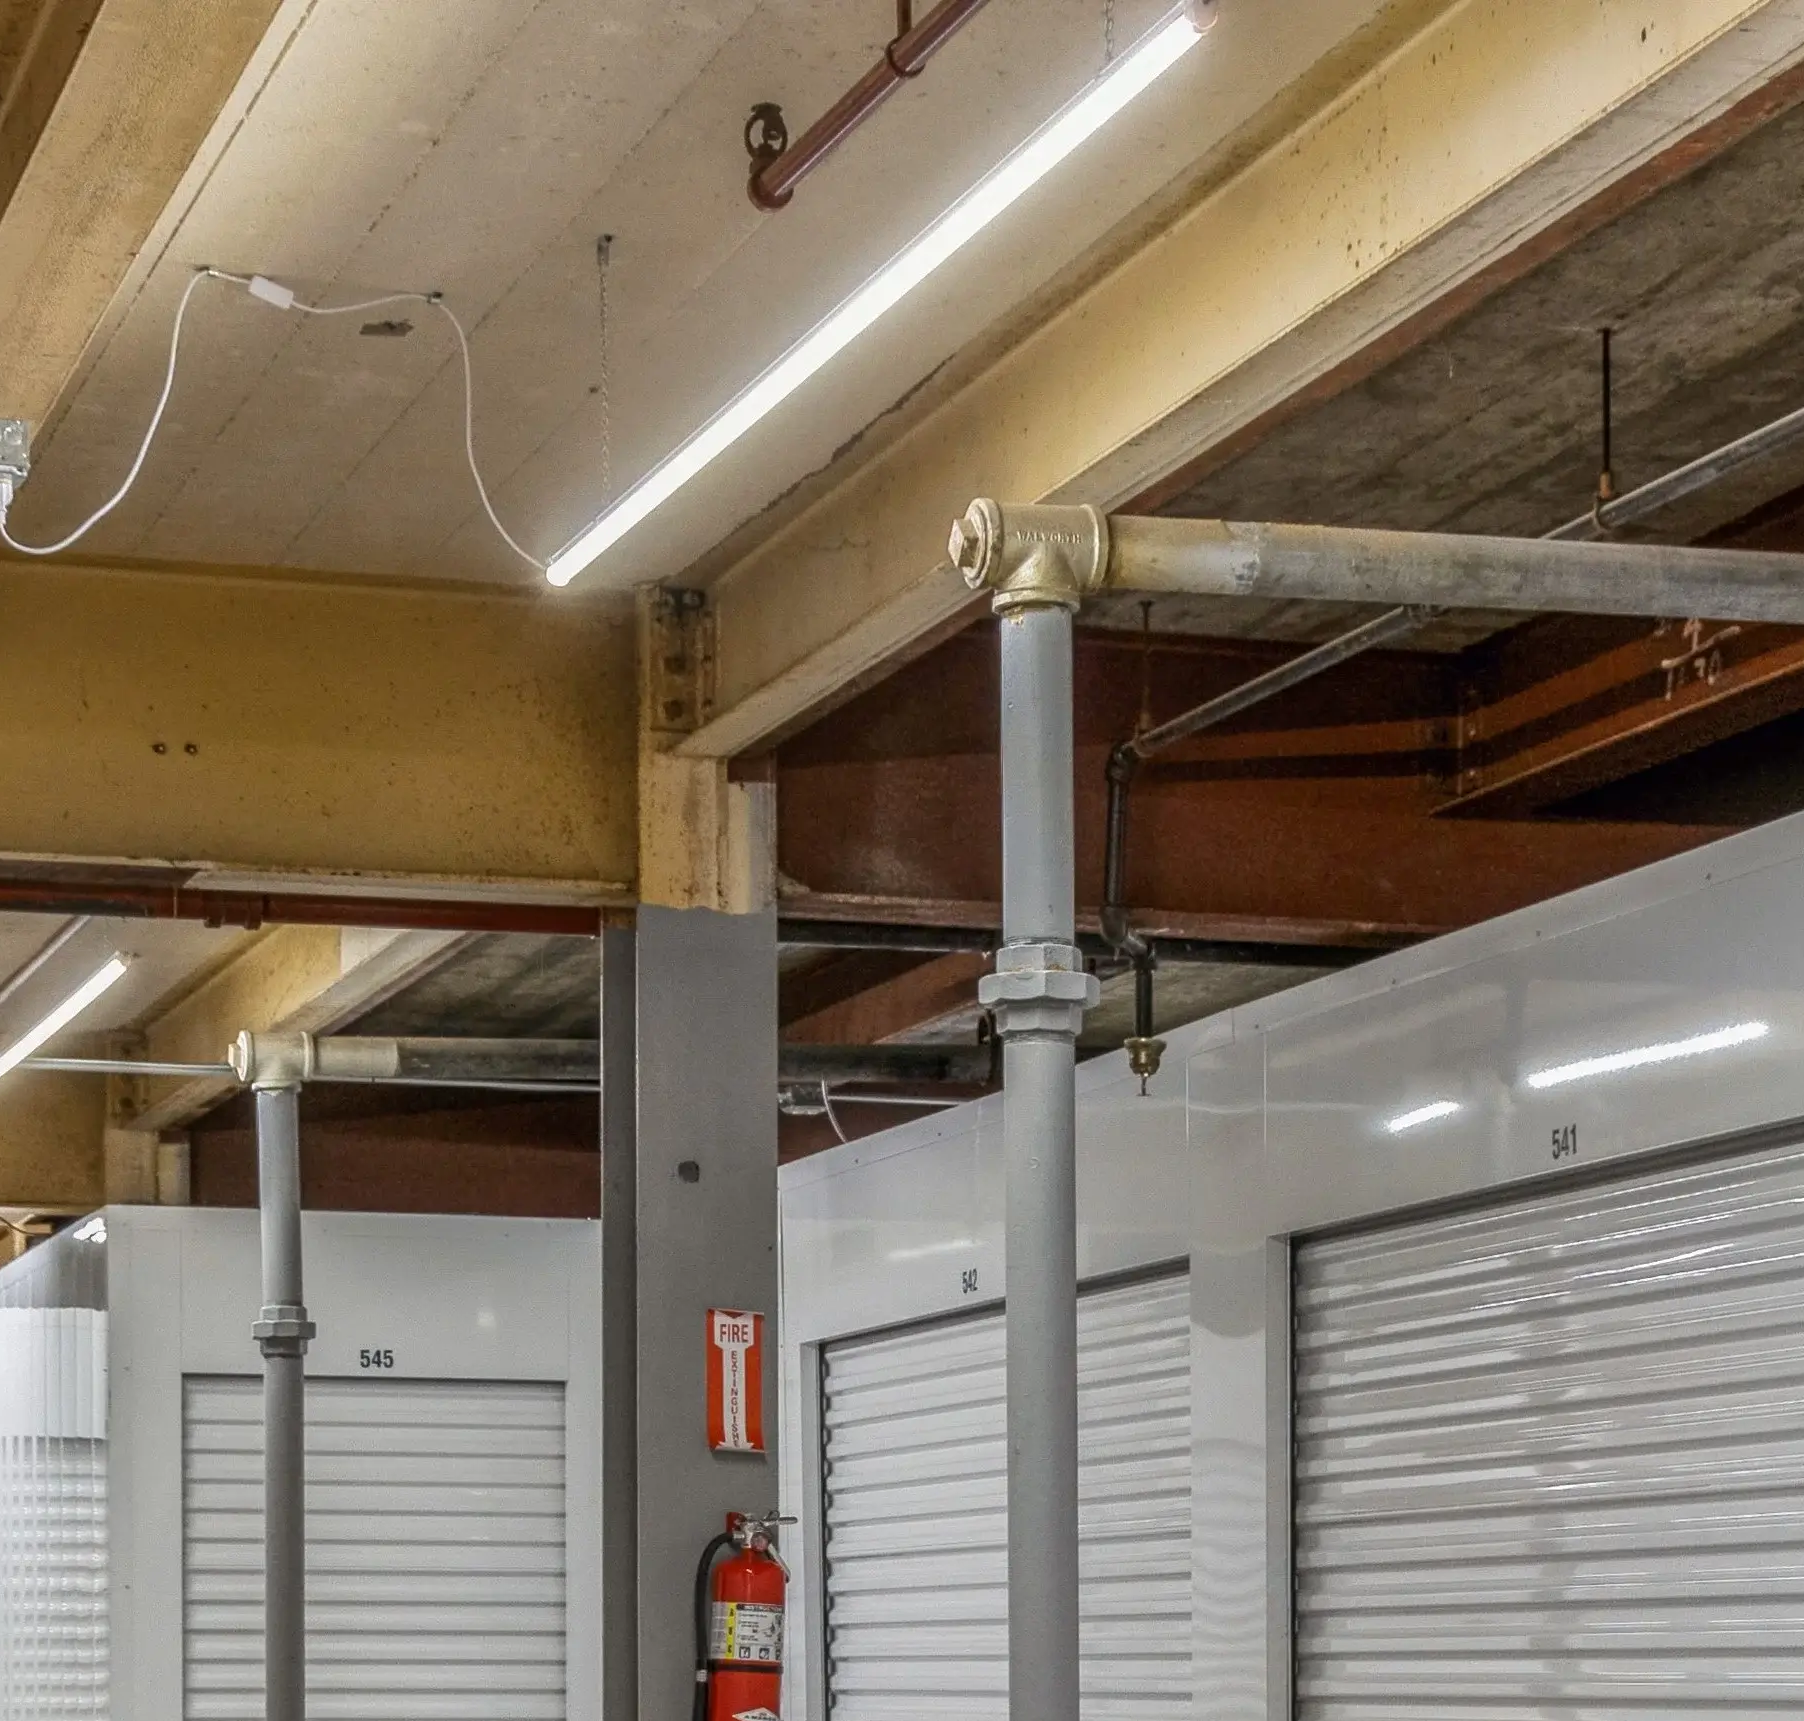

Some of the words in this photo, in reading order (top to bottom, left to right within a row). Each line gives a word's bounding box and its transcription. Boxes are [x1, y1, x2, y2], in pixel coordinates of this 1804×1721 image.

[1551, 1124, 1577, 1160] 541
[962, 1268, 978, 1294] 542
[719, 1323, 749, 1343] FIRE
[360, 1349, 394, 1368] 545
